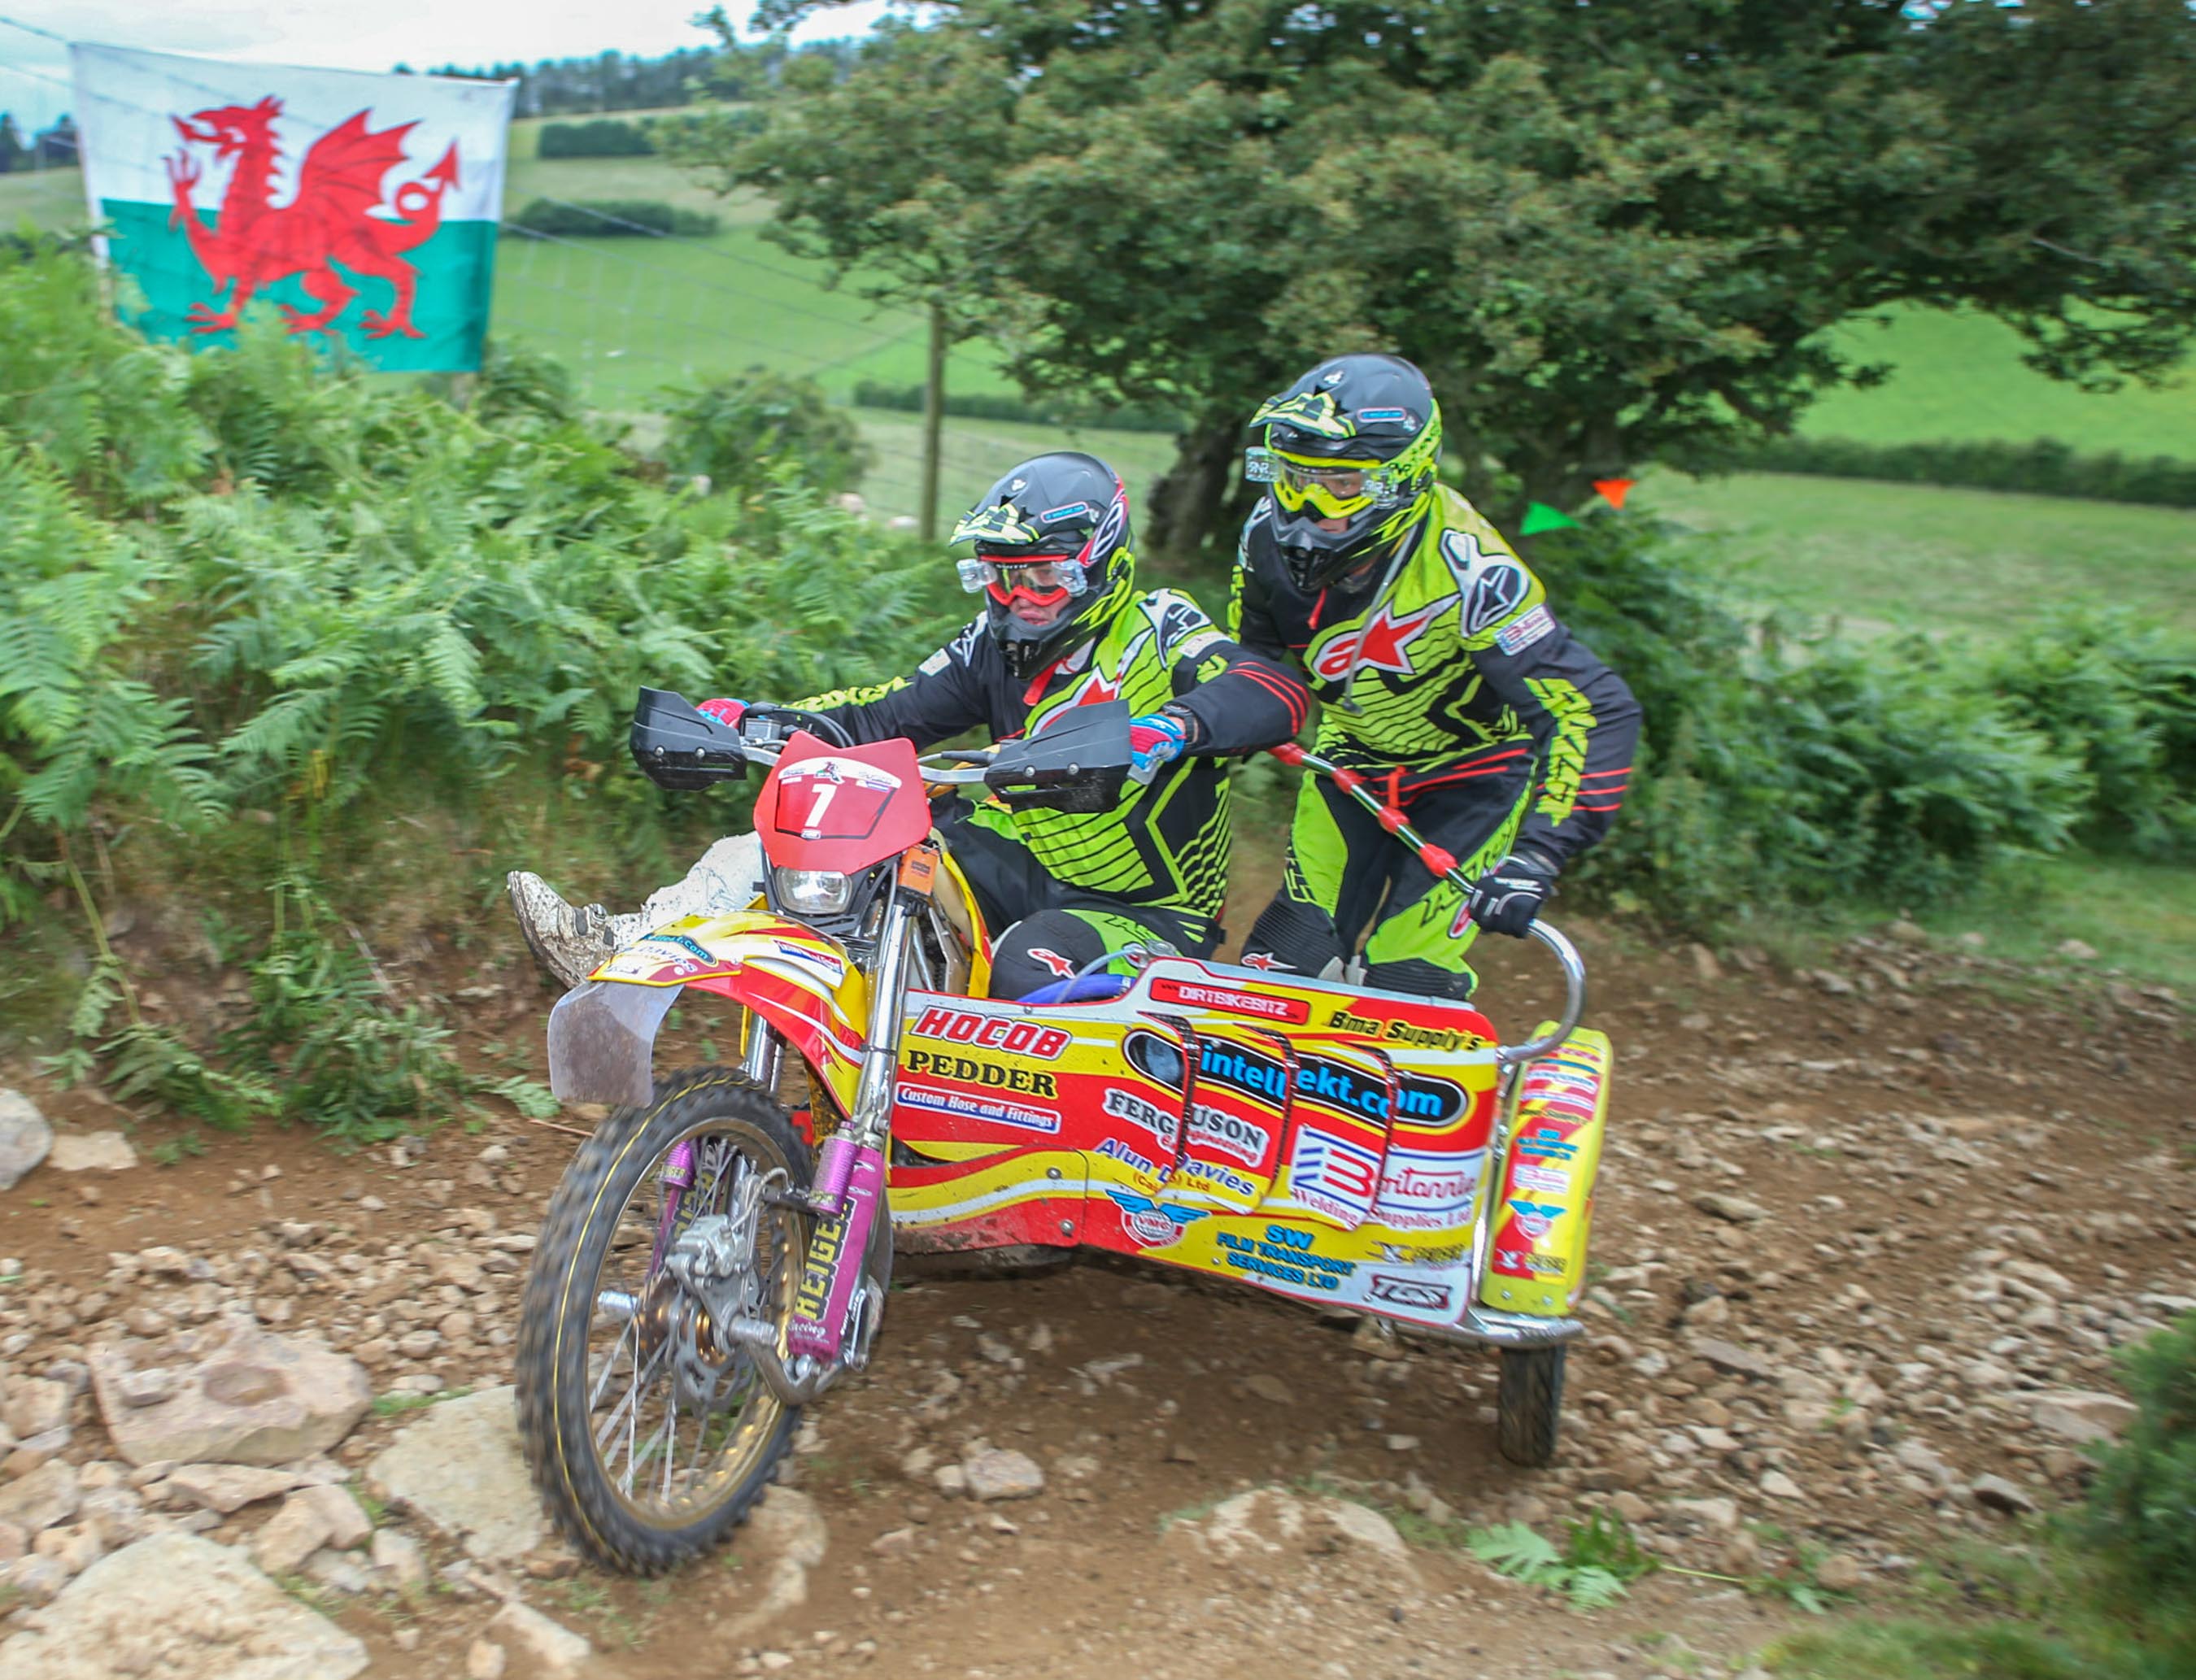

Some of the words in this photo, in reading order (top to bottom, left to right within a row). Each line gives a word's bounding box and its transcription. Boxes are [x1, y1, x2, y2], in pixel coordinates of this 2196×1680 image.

[805, 783, 837, 828] 1
[914, 1008, 1070, 1057] HOCOB
[908, 1051, 1056, 1096] PEDDER
[901, 1088, 946, 1107] Custom
[948, 1095, 978, 1114] Hose
[980, 1102, 1004, 1117] and
[1007, 1104, 1054, 1128] Fittings
[1107, 1091, 1262, 1148] FERGUSON
[1096, 1138, 1153, 1173] Alun
[1157, 1155, 1255, 1196] Davies
[1217, 1231, 1254, 1251] FILM
[1258, 1241, 1357, 1276] TRANSPORT
[1266, 1225, 1315, 1250] SW
[795, 1201, 849, 1322] REIGE
[1227, 1251, 1303, 1283] SERVICES
[1308, 1272, 1339, 1290] LTD
